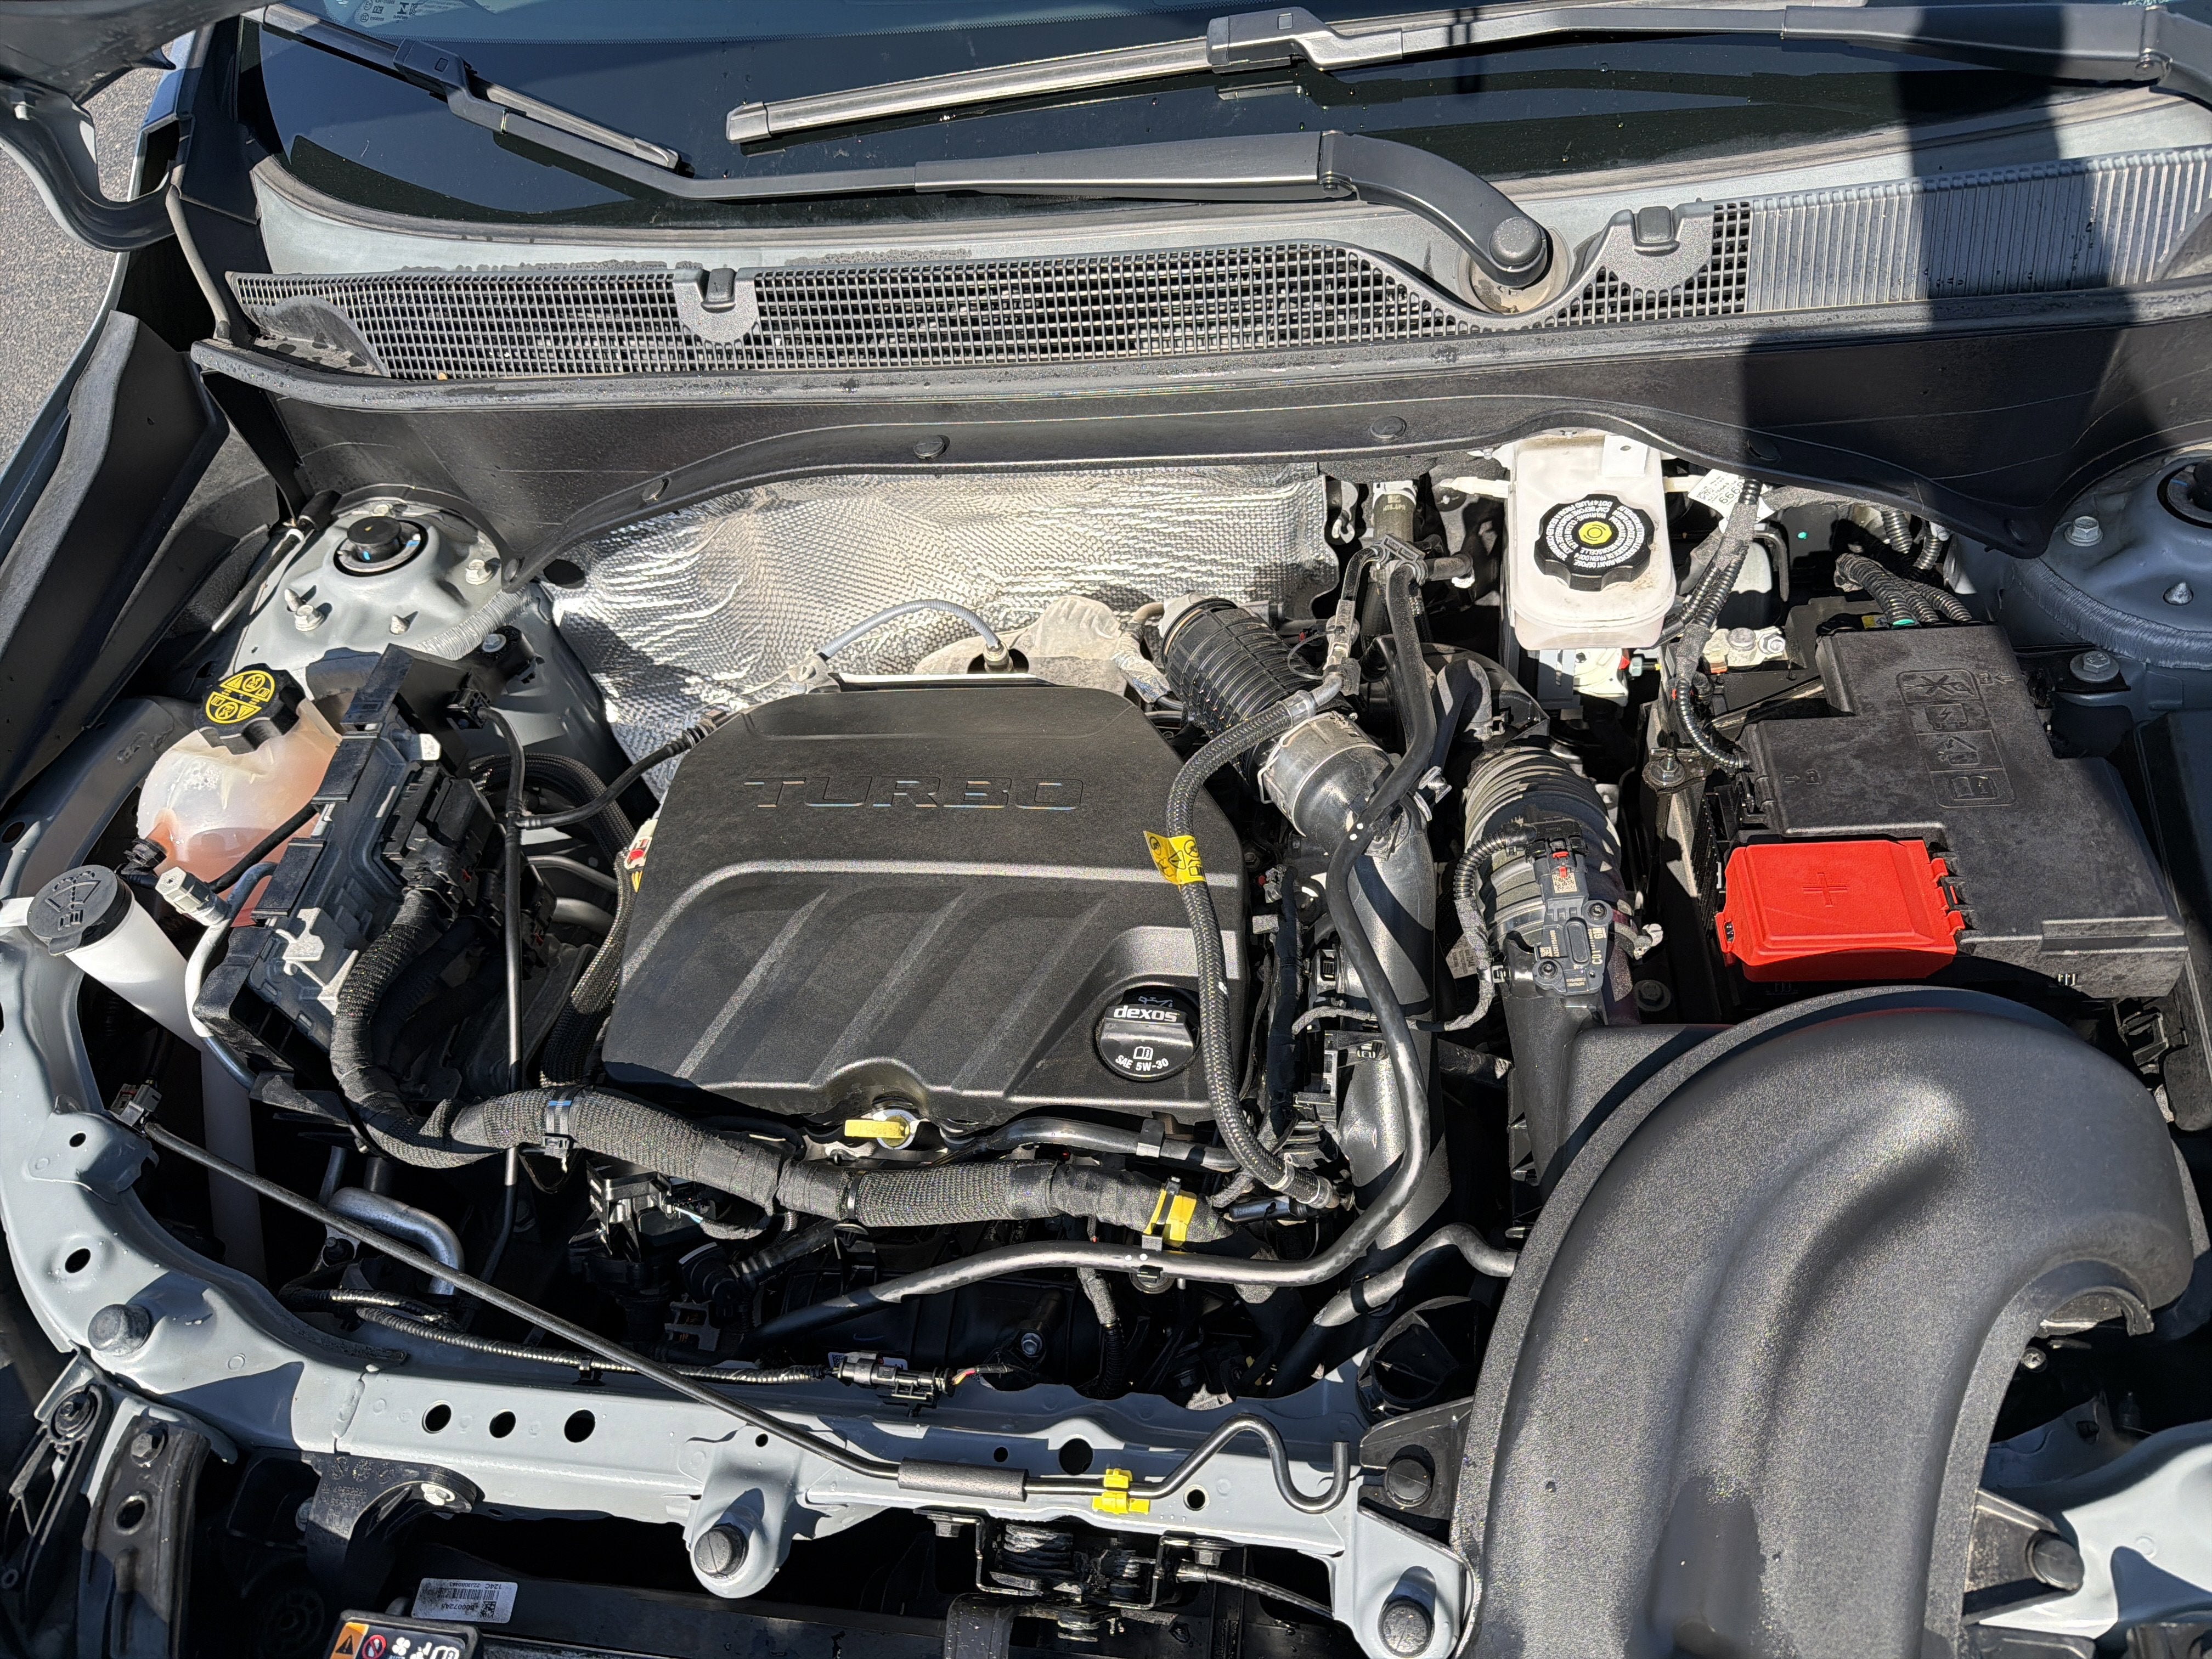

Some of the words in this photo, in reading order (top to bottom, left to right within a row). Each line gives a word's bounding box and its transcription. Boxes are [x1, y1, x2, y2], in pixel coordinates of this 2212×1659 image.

[743, 776, 1083, 810] TURBO
[1113, 1005, 1178, 1023] dexos
[1115, 1054, 1133, 1069] SAE
[1135, 1058, 1169, 1071] 5W-30
